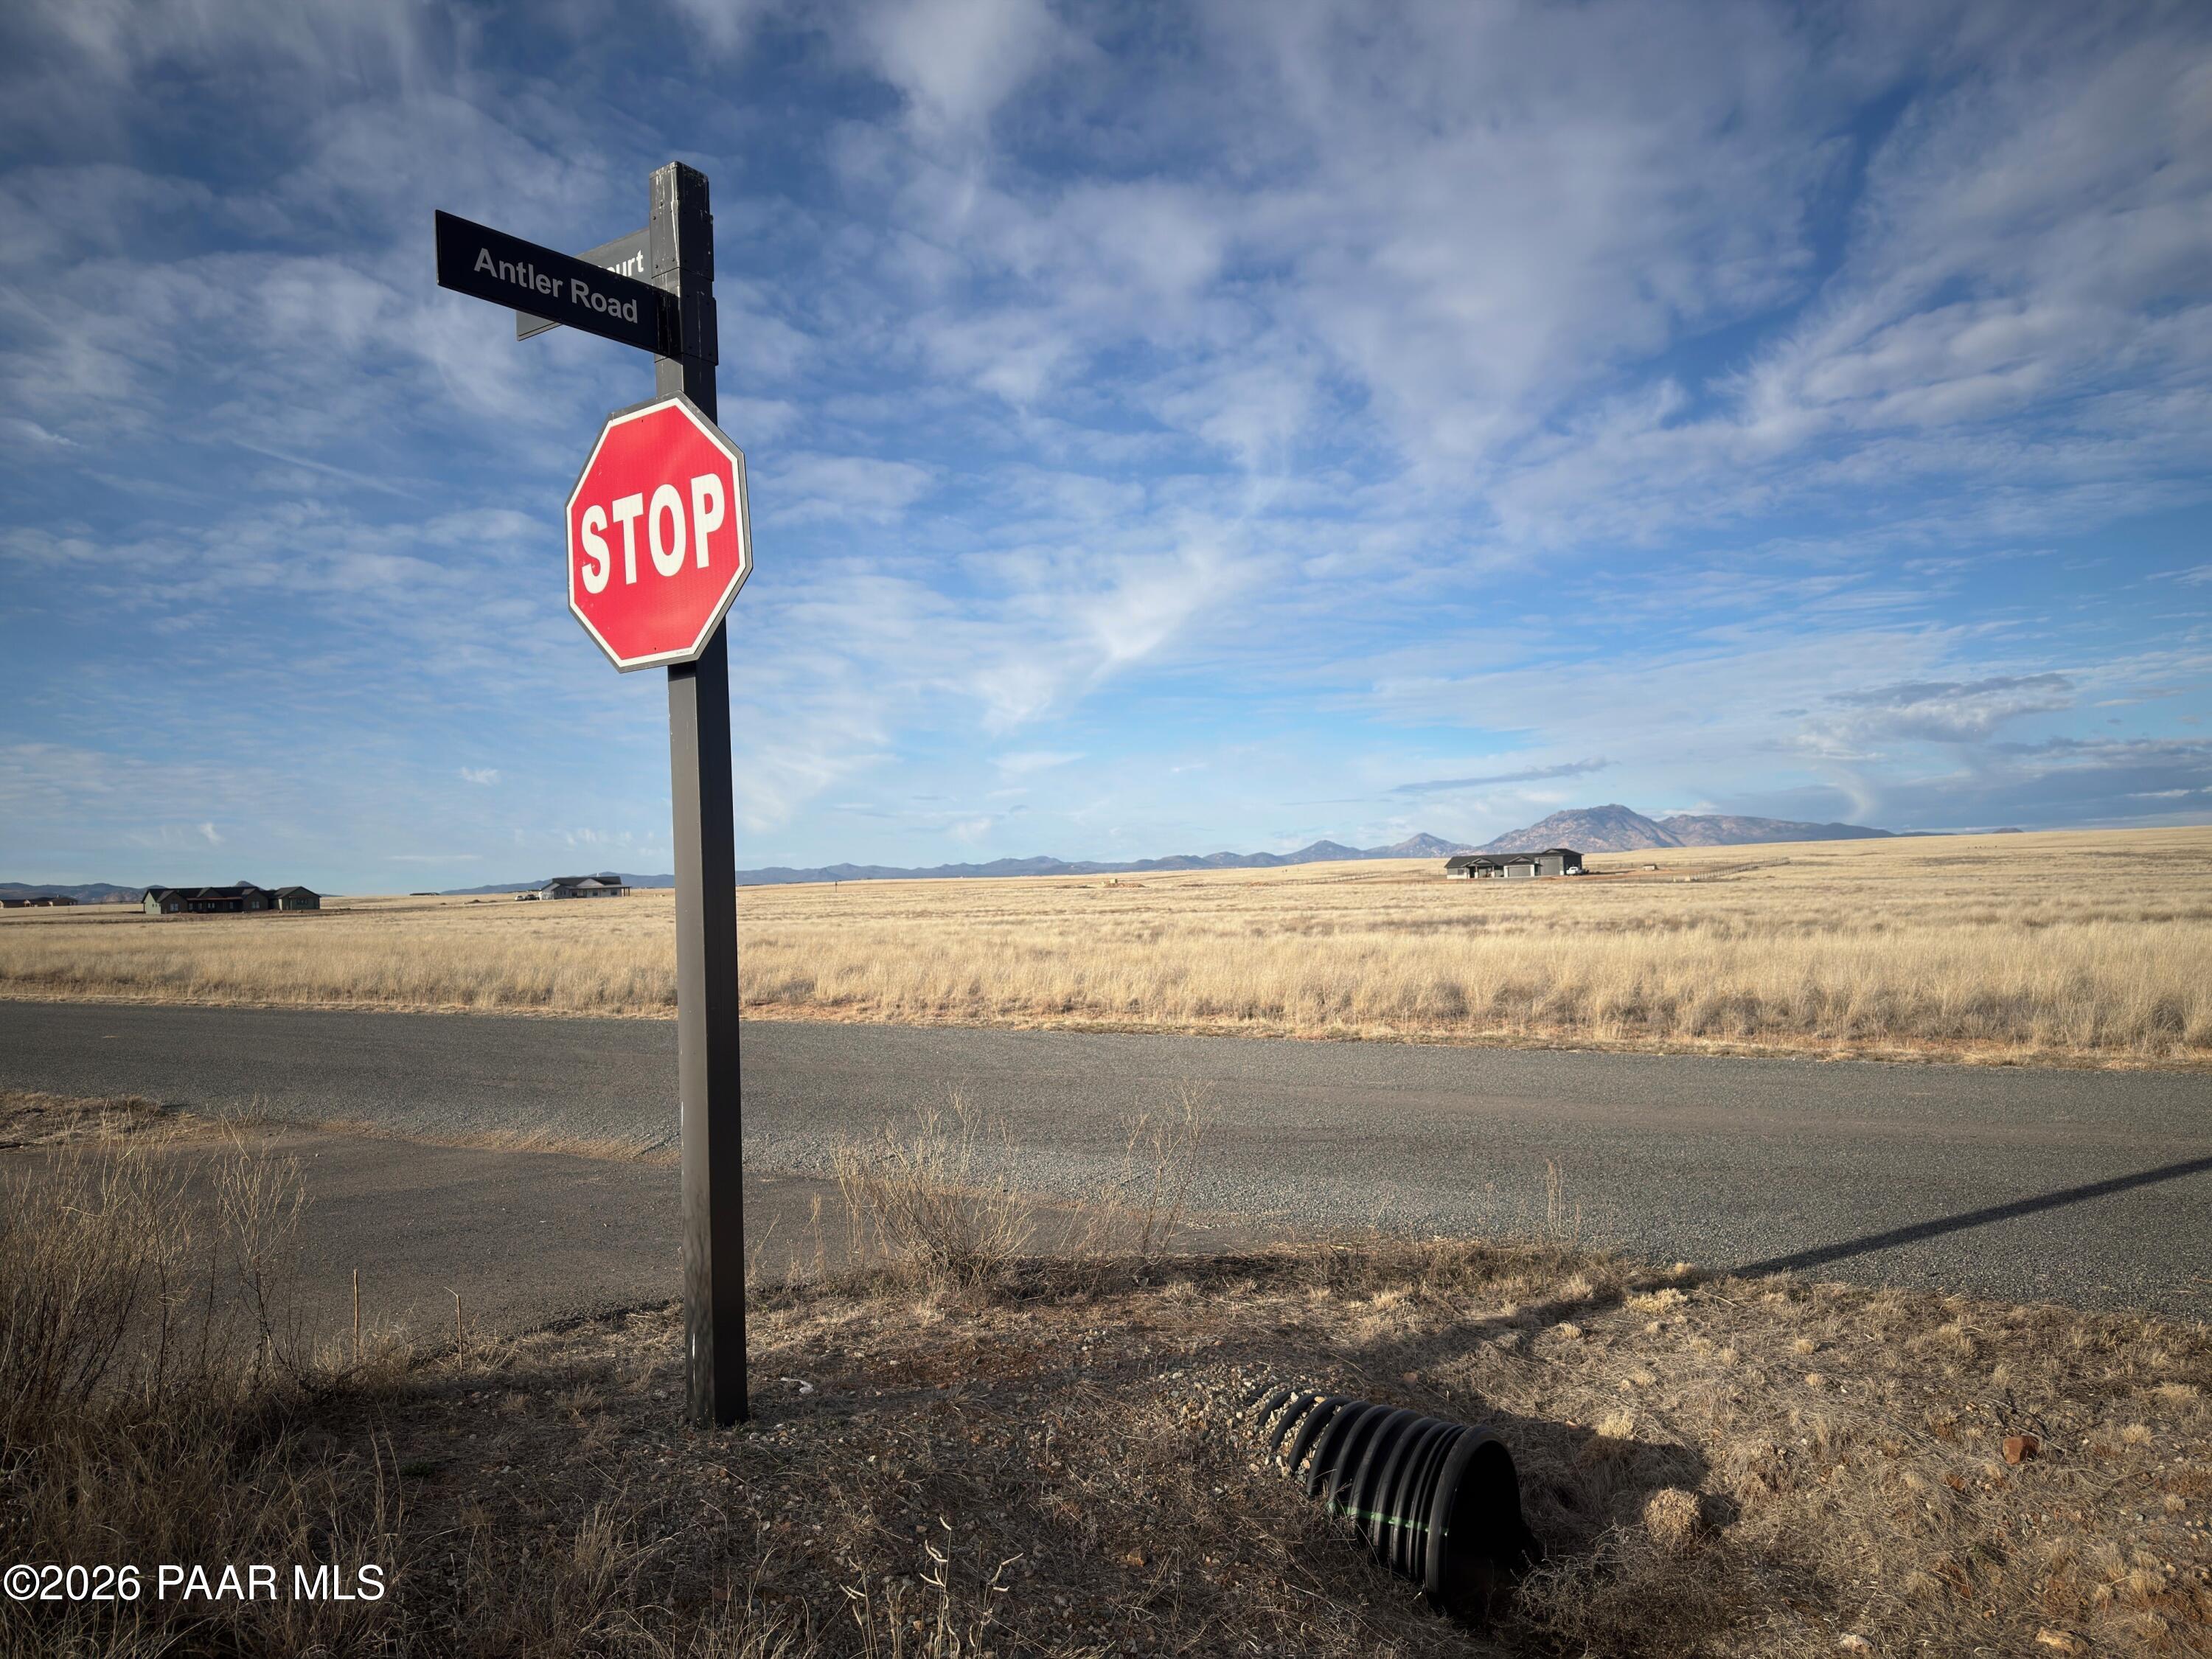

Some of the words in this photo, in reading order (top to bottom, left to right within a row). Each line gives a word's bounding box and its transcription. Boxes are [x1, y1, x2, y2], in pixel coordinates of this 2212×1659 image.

[473, 248, 563, 298] Antler
[571, 278, 638, 324] Road
[581, 473, 725, 594] STOP
